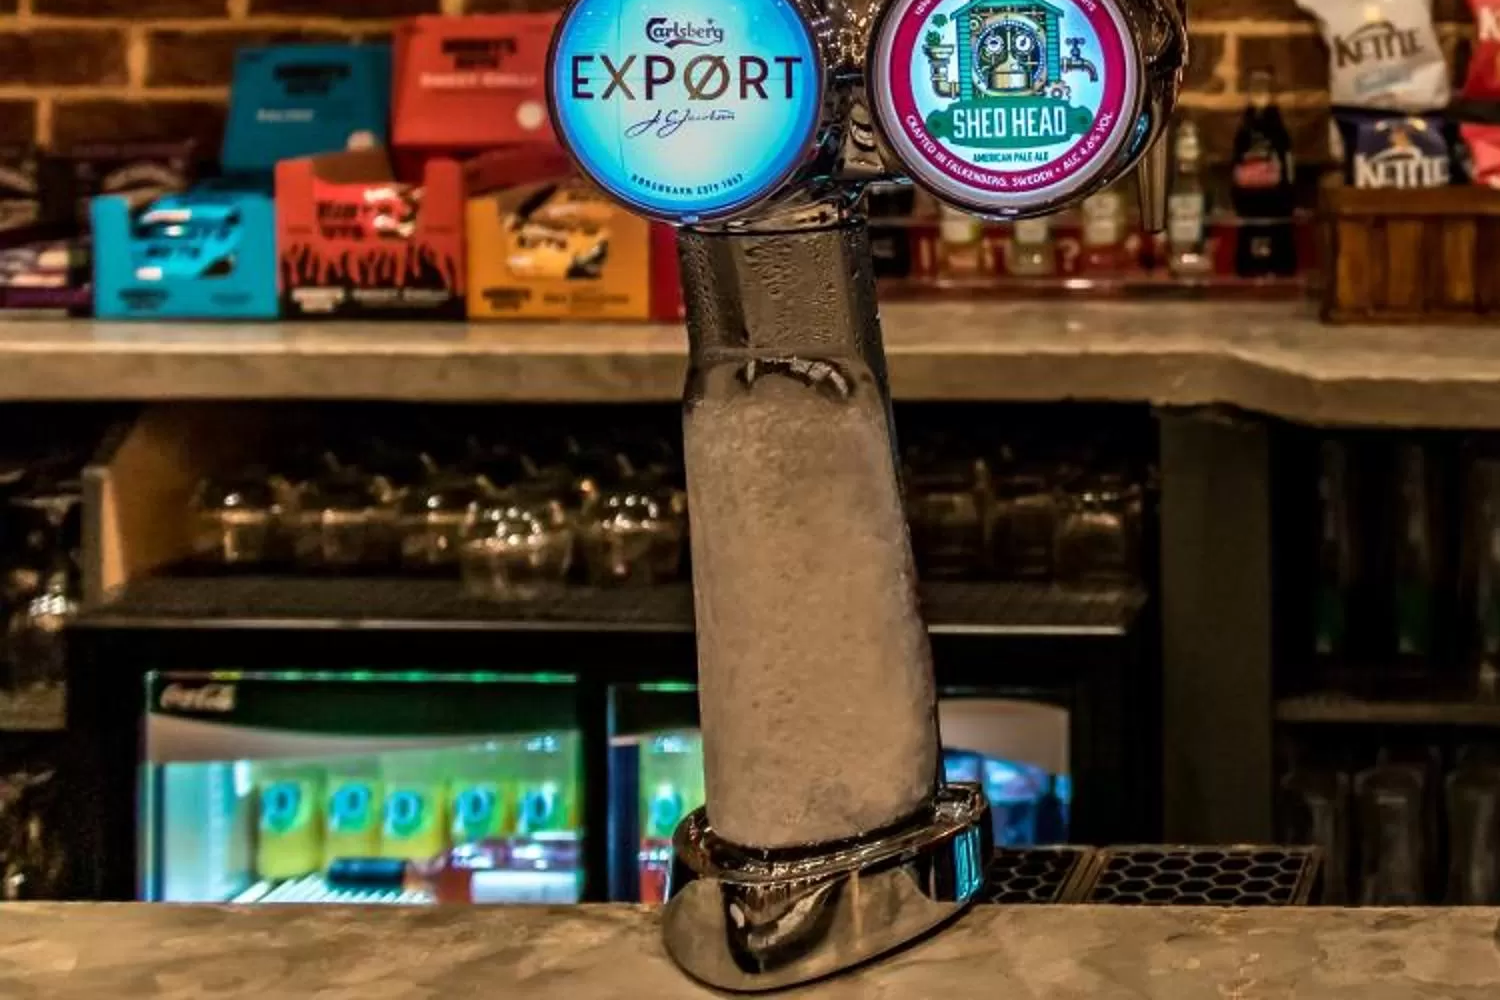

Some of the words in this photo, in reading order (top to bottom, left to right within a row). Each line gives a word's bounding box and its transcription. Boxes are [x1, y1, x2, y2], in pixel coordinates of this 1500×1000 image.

[645, 17, 724, 49] Carlsberg
[953, 107, 1006, 139] SHED
[1012, 105, 1067, 137] HEAD
[973, 153, 1012, 163] AMERICAN
[1013, 153, 1034, 162] PALE
[1034, 152, 1049, 162] ALE
[1011, 170, 1053, 187] SWEDEN
